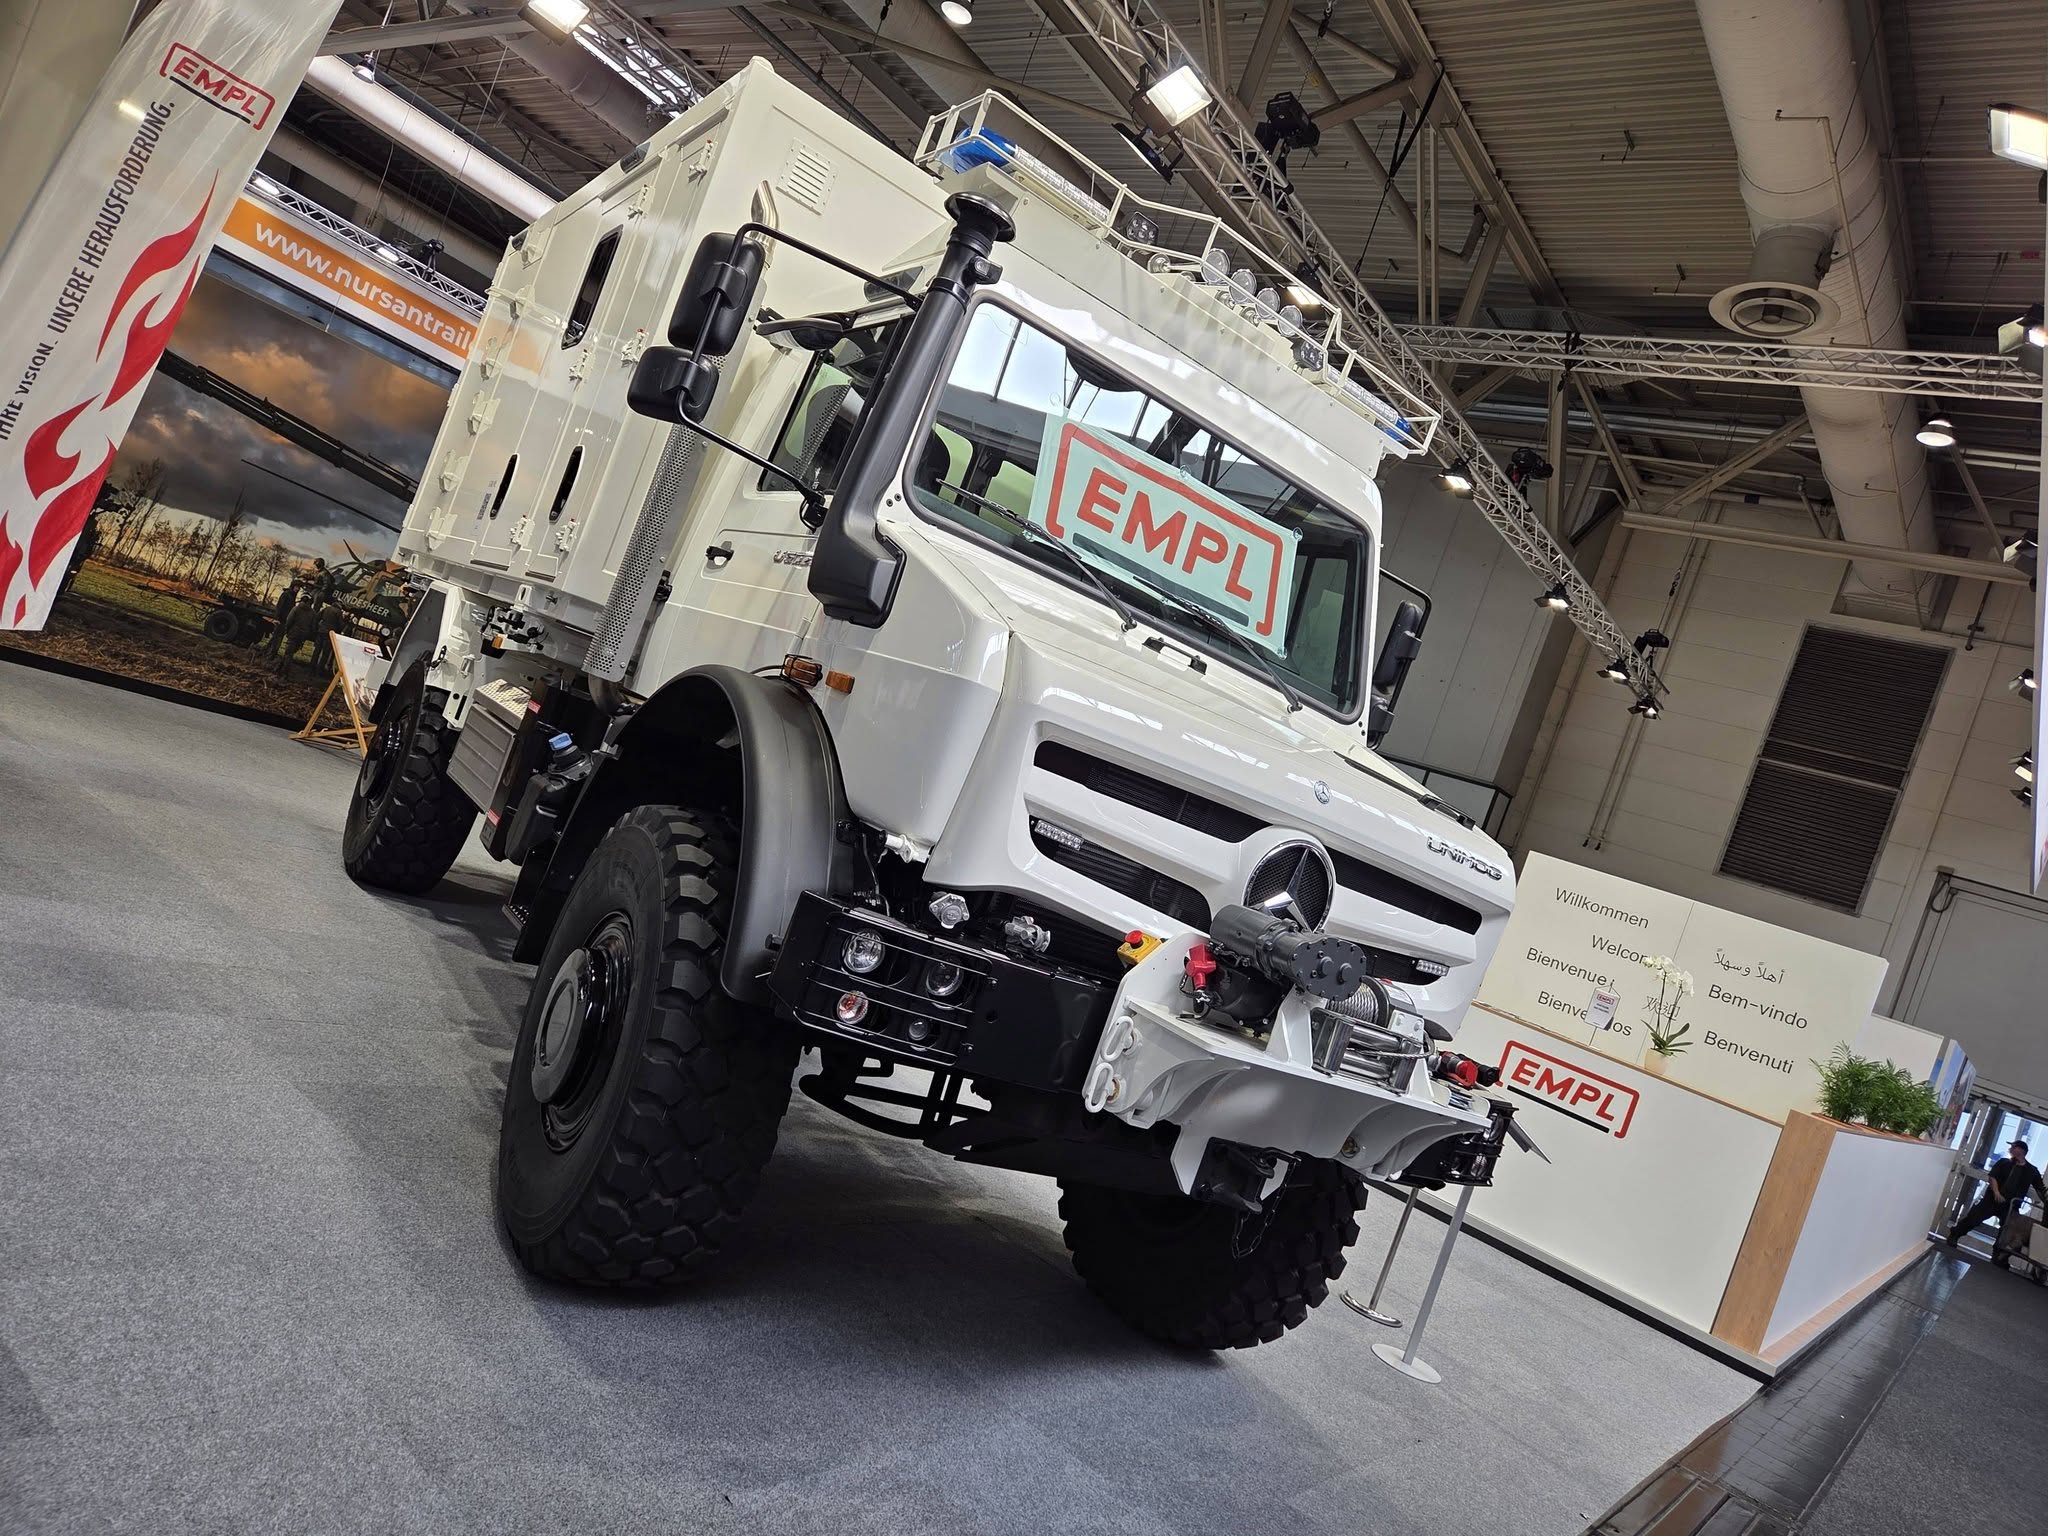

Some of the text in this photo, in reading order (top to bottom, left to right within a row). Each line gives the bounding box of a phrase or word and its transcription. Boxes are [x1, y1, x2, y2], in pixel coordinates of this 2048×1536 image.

[173, 56, 256, 116] EMPL
[47, 266, 94, 333] UNSERE
[78, 100, 175, 268] HERAUSFORDERUNG.
[256, 222, 473, 350] www.nursantrail
[1076, 467, 1253, 602] EMPL
[332, 590, 390, 617] BUNDESHEER
[1427, 836, 1503, 881] UNIMOG
[1555, 887, 1649, 929] Willkommen
[1526, 947, 1607, 986] Bienvenue
[1592, 934, 1649, 964] Welco
[1537, 991, 1632, 1036] Bienveos
[1708, 984, 1808, 1029] Bem-vindo
[1704, 1030, 1794, 1074] Benvenuti
[1511, 1057, 1614, 1121] EMPL
